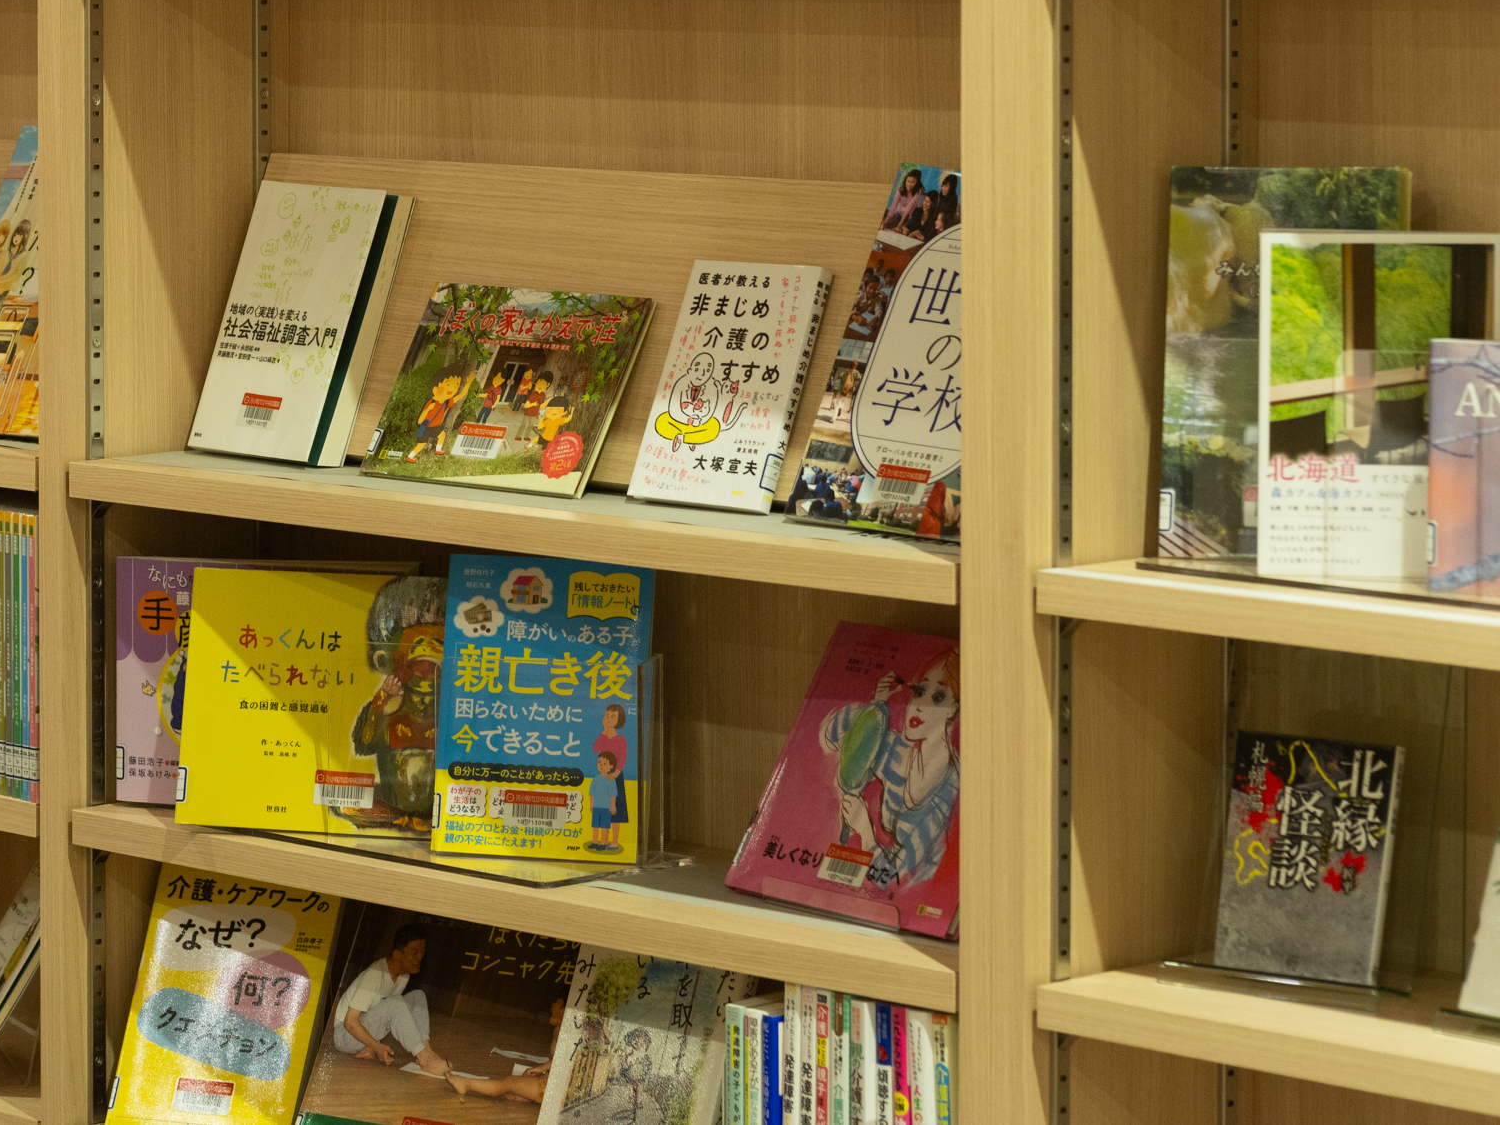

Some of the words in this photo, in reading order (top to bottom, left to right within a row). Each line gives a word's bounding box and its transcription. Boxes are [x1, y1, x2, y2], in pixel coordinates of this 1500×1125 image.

[698, 272, 771, 289] 医者が教える
[689, 293, 770, 318] 非まじめ
[908, 268, 961, 326] 世
[230, 302, 308, 322] 地域の〈実践〉を変える
[439, 302, 629, 345] ぼくの家はかえで荘
[223, 316, 338, 349] 社会福祉調査入門
[702, 326, 770, 351] 介護の
[925, 335, 961, 371] の
[720, 359, 780, 384] すすめ
[750, 407, 771, 419] 現実
[872, 367, 961, 433] 学校
[692, 455, 759, 477] 大塚宣夫
[1266, 455, 1360, 484] 北海道
[148, 564, 190, 590] なにも
[573, 581, 635, 593] 残しておきたい
[570, 592, 638, 610] 「情報ノート」
[239, 624, 341, 652] あっくんは
[505, 619, 641, 646] 障がいのある子が
[221, 660, 354, 688] たべられない
[239, 700, 329, 714] 食の困難と感覚過敏
[454, 697, 583, 722] 困らないために
[261, 738, 302, 748] 作・あっくん
[451, 724, 581, 757] 今できること
[453, 764, 580, 782] 自分に万一のことがあったら…
[450, 786, 482, 796] わが子の
[453, 795, 478, 805] 生活は
[1330, 748, 1388, 853] 北縁
[1268, 785, 1325, 891] 怪談
[762, 839, 824, 868] 美しくなり
[167, 875, 330, 913] 介護・ケアワークの
[175, 918, 266, 951] なぜ？
[461, 951, 576, 985] コンニャク先
[233, 972, 292, 1007] 何？
